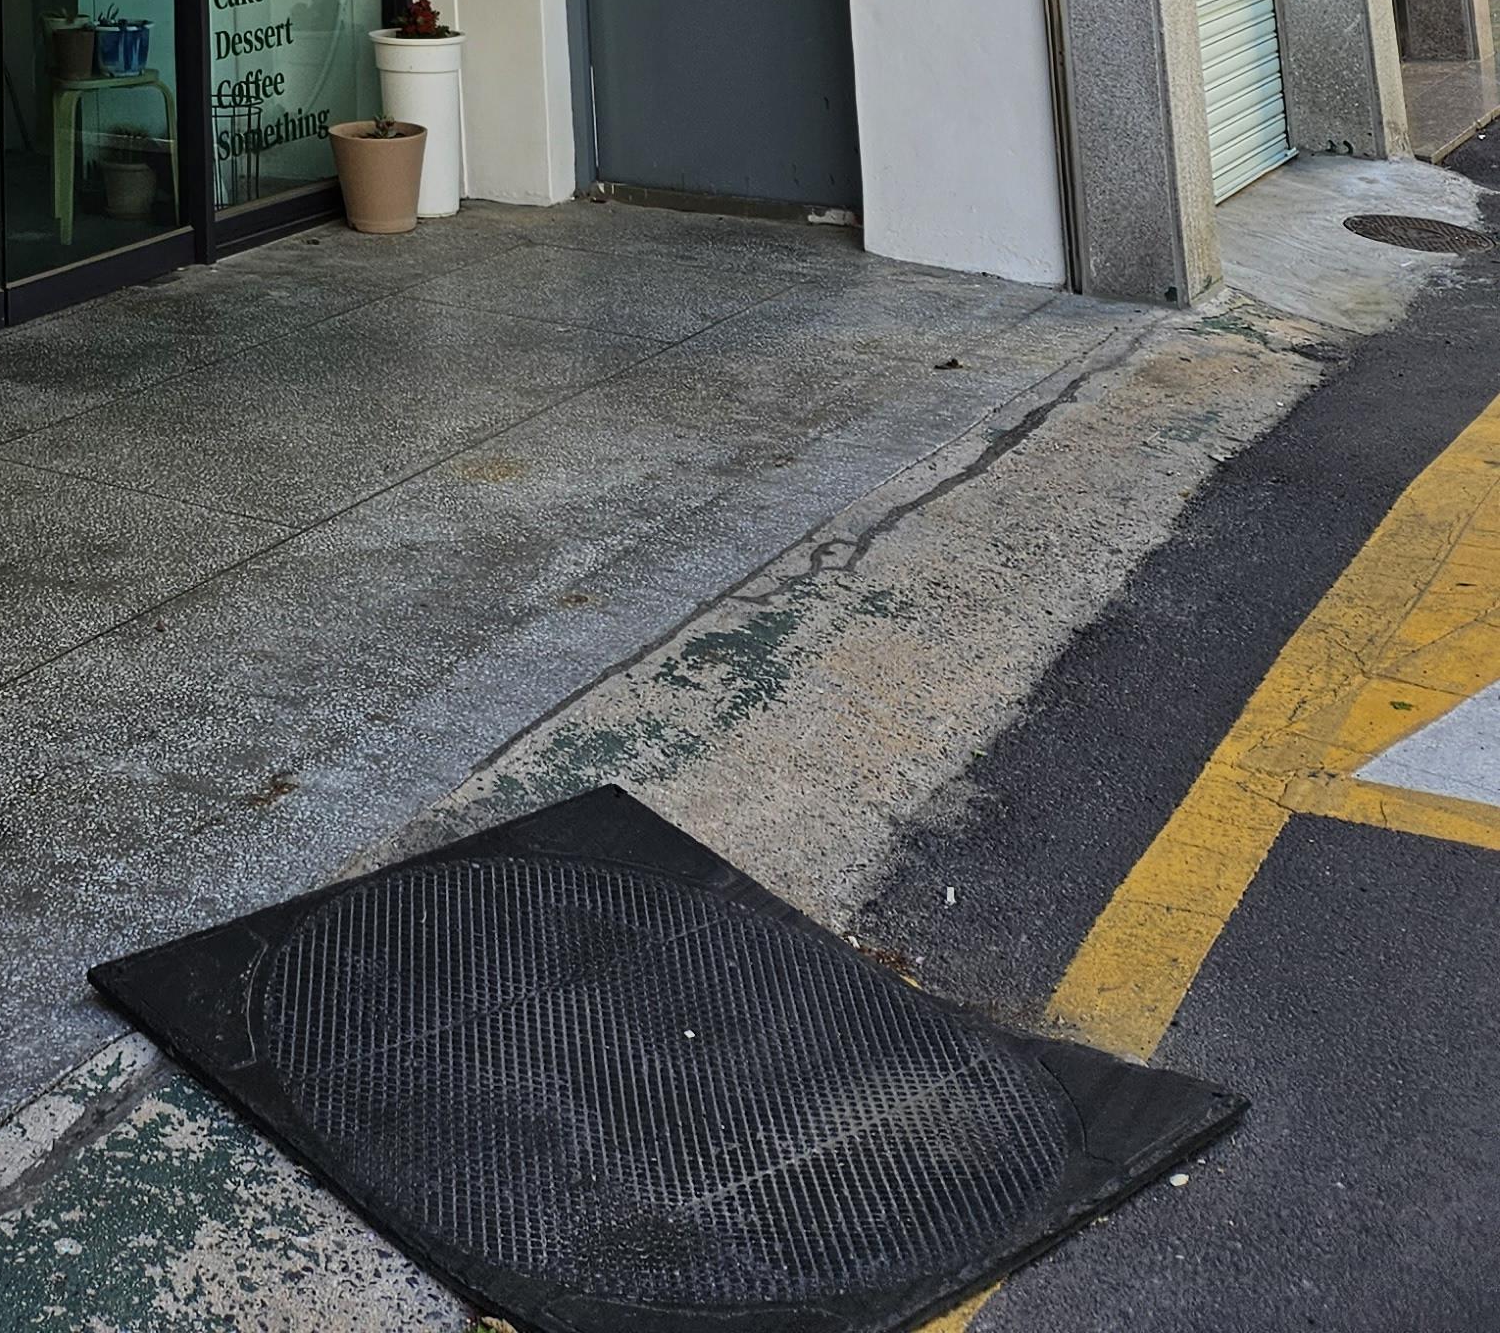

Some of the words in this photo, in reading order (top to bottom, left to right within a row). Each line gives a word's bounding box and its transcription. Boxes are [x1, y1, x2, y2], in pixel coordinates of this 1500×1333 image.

[214, 17, 294, 60] Dessert
[217, 68, 285, 109] Coffee
[217, 107, 330, 161] Something
